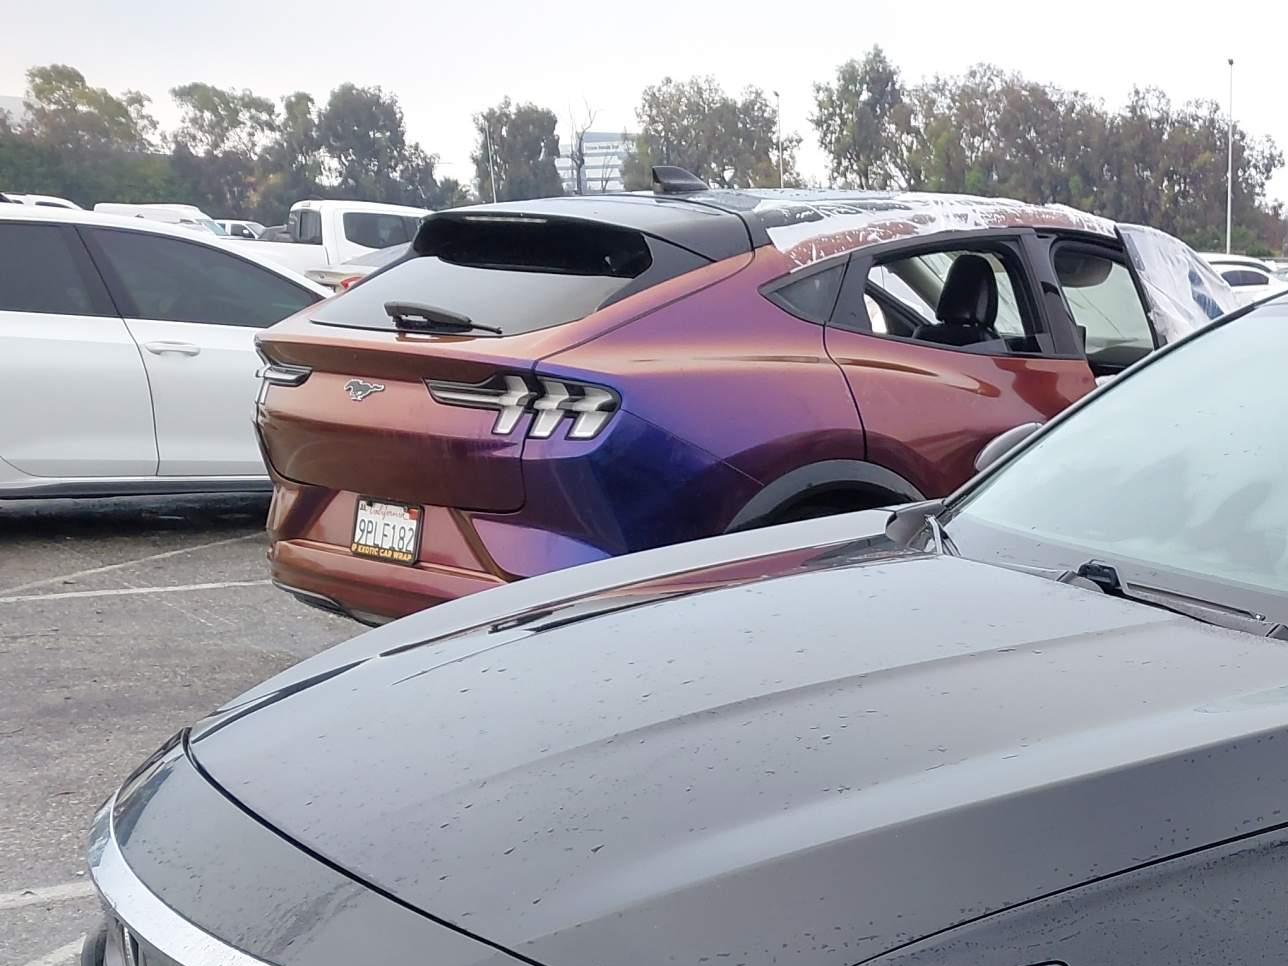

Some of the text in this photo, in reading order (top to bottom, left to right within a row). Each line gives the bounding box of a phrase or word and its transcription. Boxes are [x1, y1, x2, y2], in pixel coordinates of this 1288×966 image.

[357, 519, 414, 553] 9PLF182
[358, 545, 378, 555] EXOTIC
[379, 548, 393, 558] CAR
[393, 551, 412, 561] WRAP
